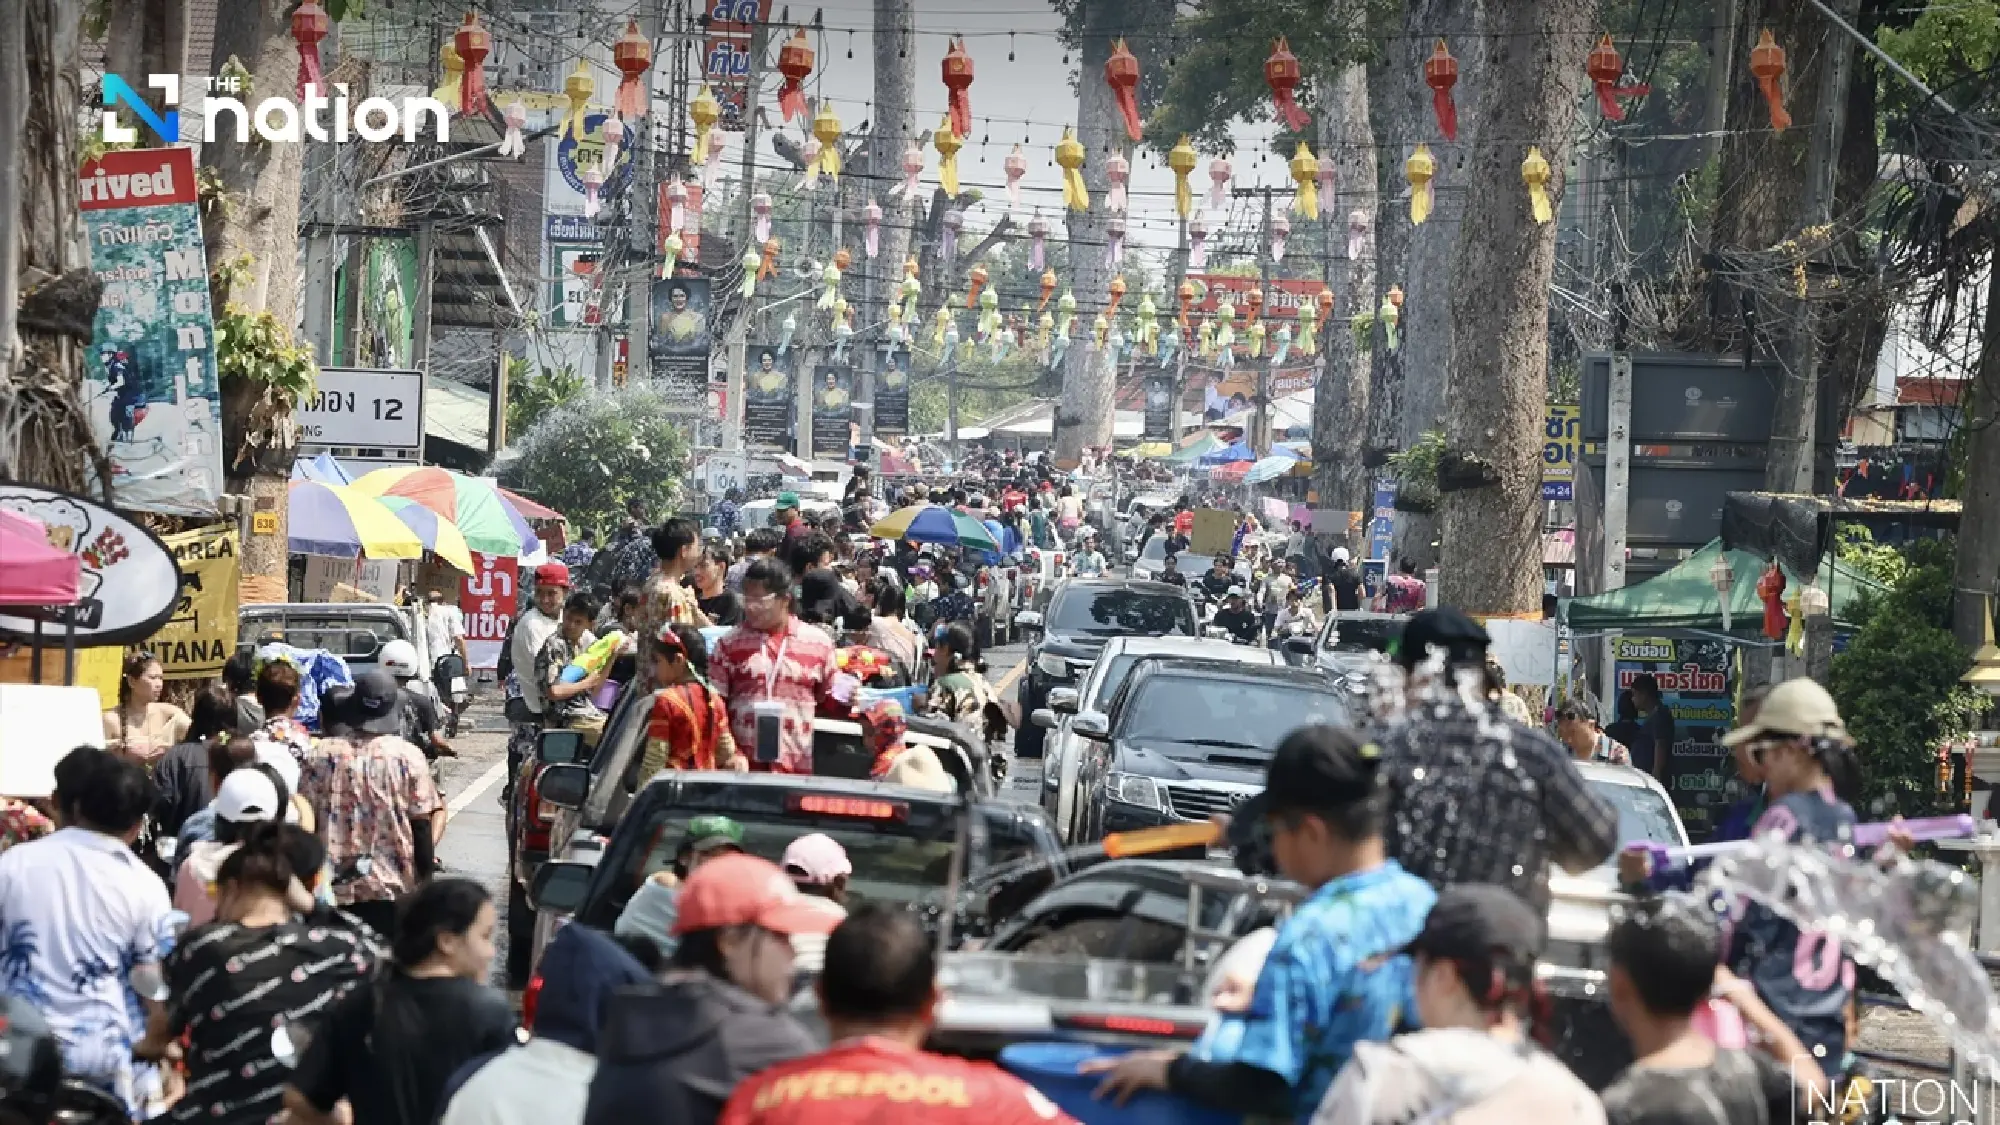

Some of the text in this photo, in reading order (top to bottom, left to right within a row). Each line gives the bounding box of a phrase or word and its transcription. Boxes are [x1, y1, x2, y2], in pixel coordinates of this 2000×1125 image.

[80, 163, 176, 202] rived
[550, 218, 596, 239] เชียงใหม
[372, 398, 403, 420] 12
[753, 1069, 971, 1110] LIVERPOOL
